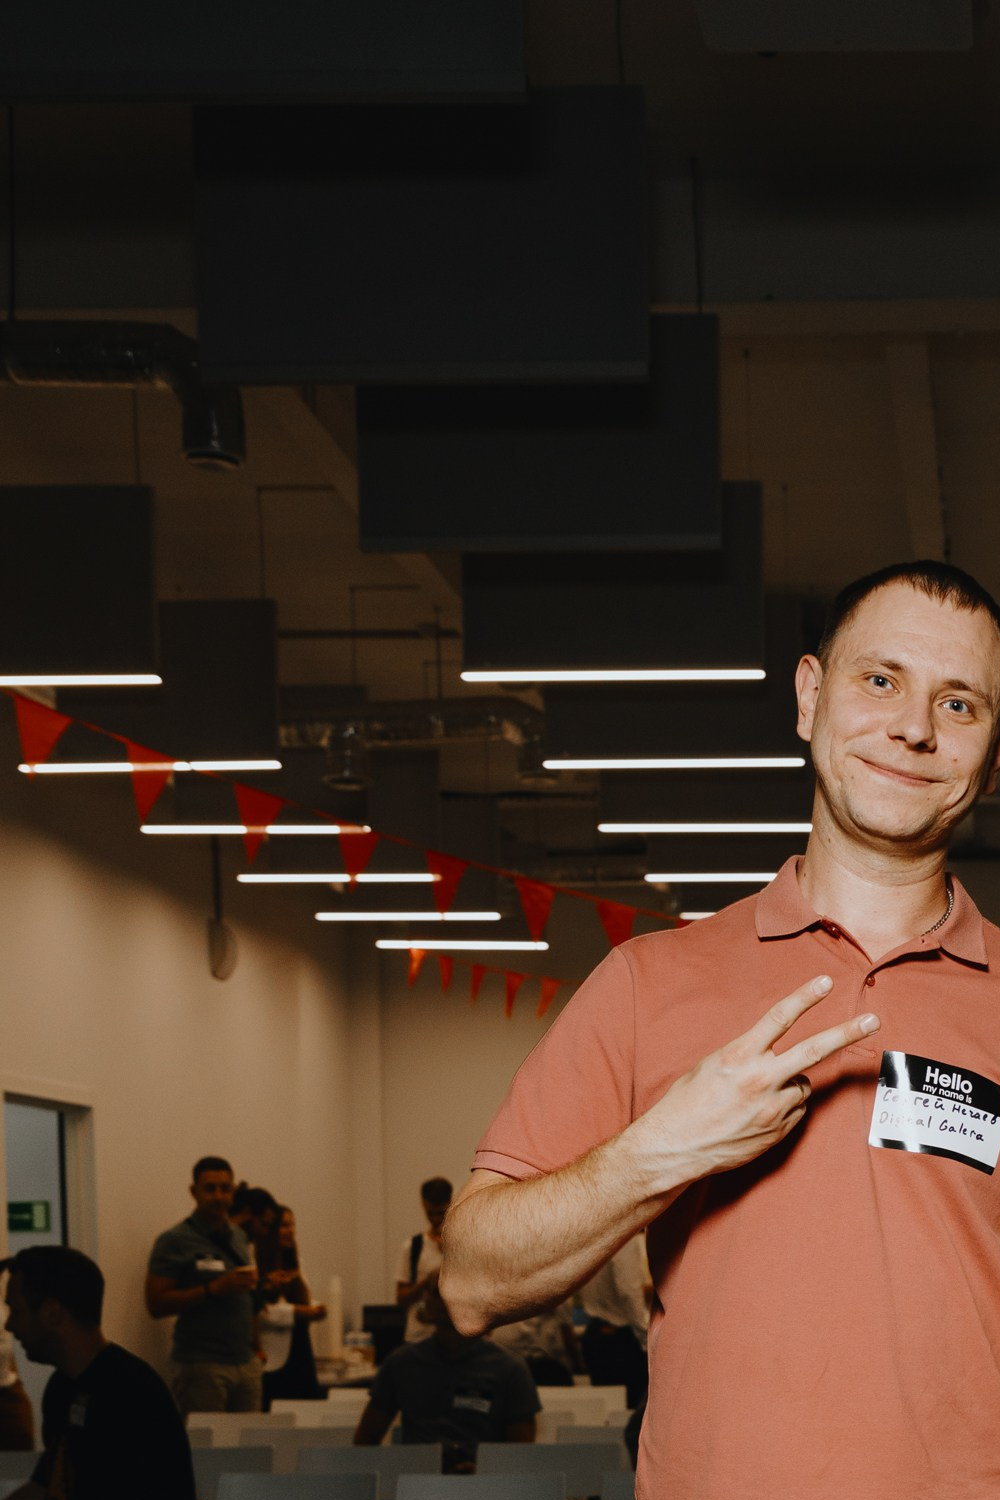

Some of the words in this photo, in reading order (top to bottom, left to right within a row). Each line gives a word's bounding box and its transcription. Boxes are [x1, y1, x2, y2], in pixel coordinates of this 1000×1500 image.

[925, 1066, 973, 1094] Hello
[883, 1089, 945, 1110] Сегей
[922, 1084, 937, 1094] my
[939, 1088, 965, 1102] name
[966, 1094, 973, 1104] is
[939, 1120, 984, 1142] Galera
